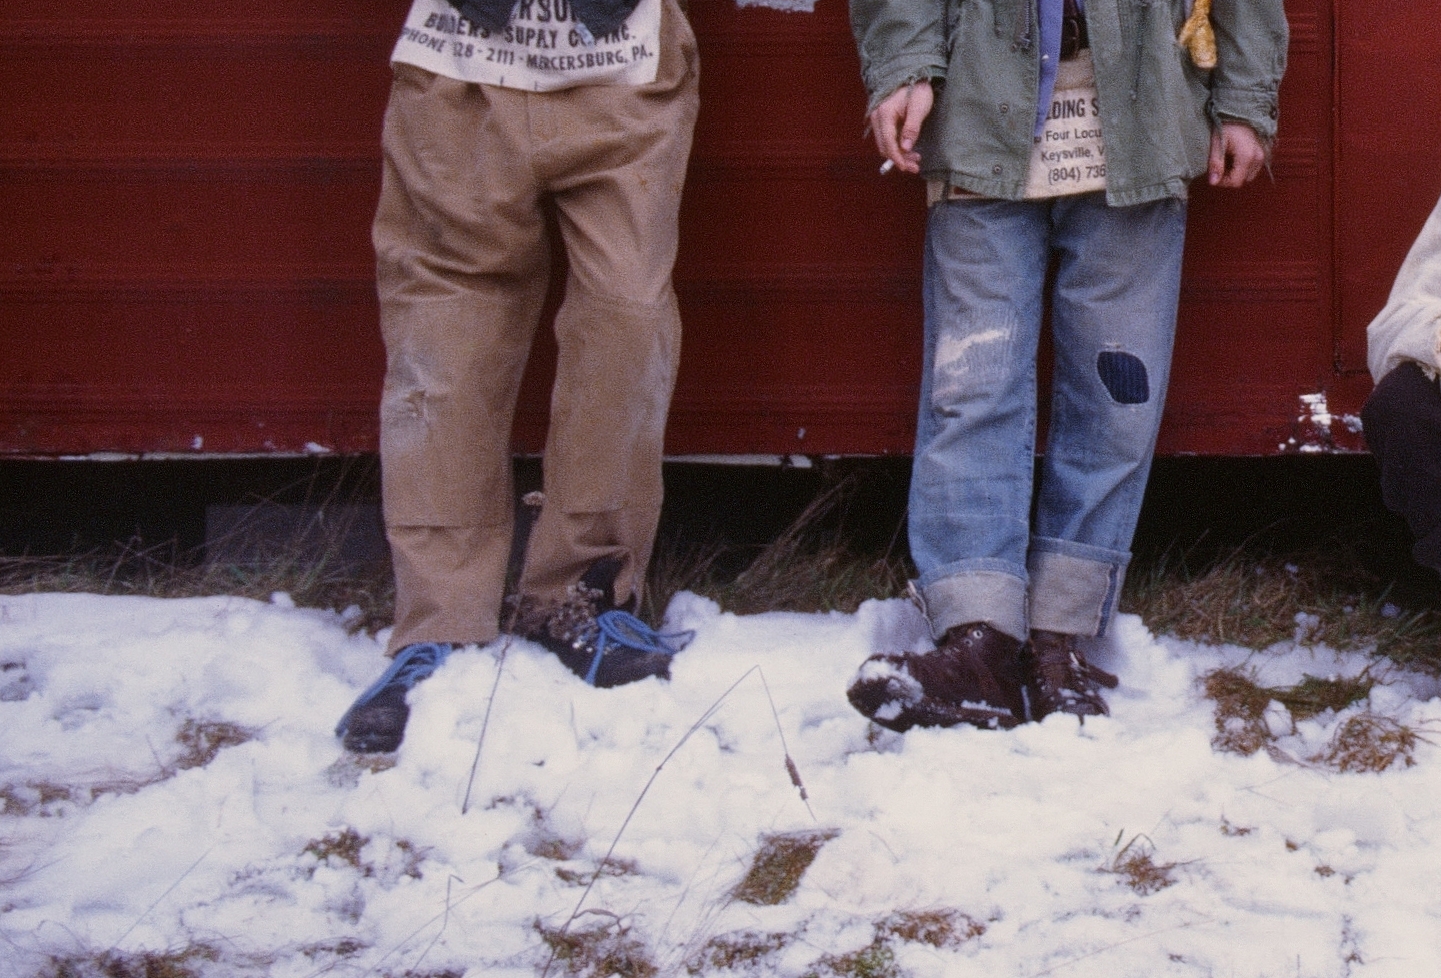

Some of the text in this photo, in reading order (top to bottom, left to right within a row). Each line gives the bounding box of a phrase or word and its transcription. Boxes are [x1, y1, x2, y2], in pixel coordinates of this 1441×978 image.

[404, 27, 446, 53] PHONE
[632, 44, 653, 61] PA.
[1046, 99, 1085, 120] DING
[1046, 128, 1102, 141] Four Locu
[1041, 146, 1094, 162] Keysville,
[1048, 166, 1081, 185] (804)
